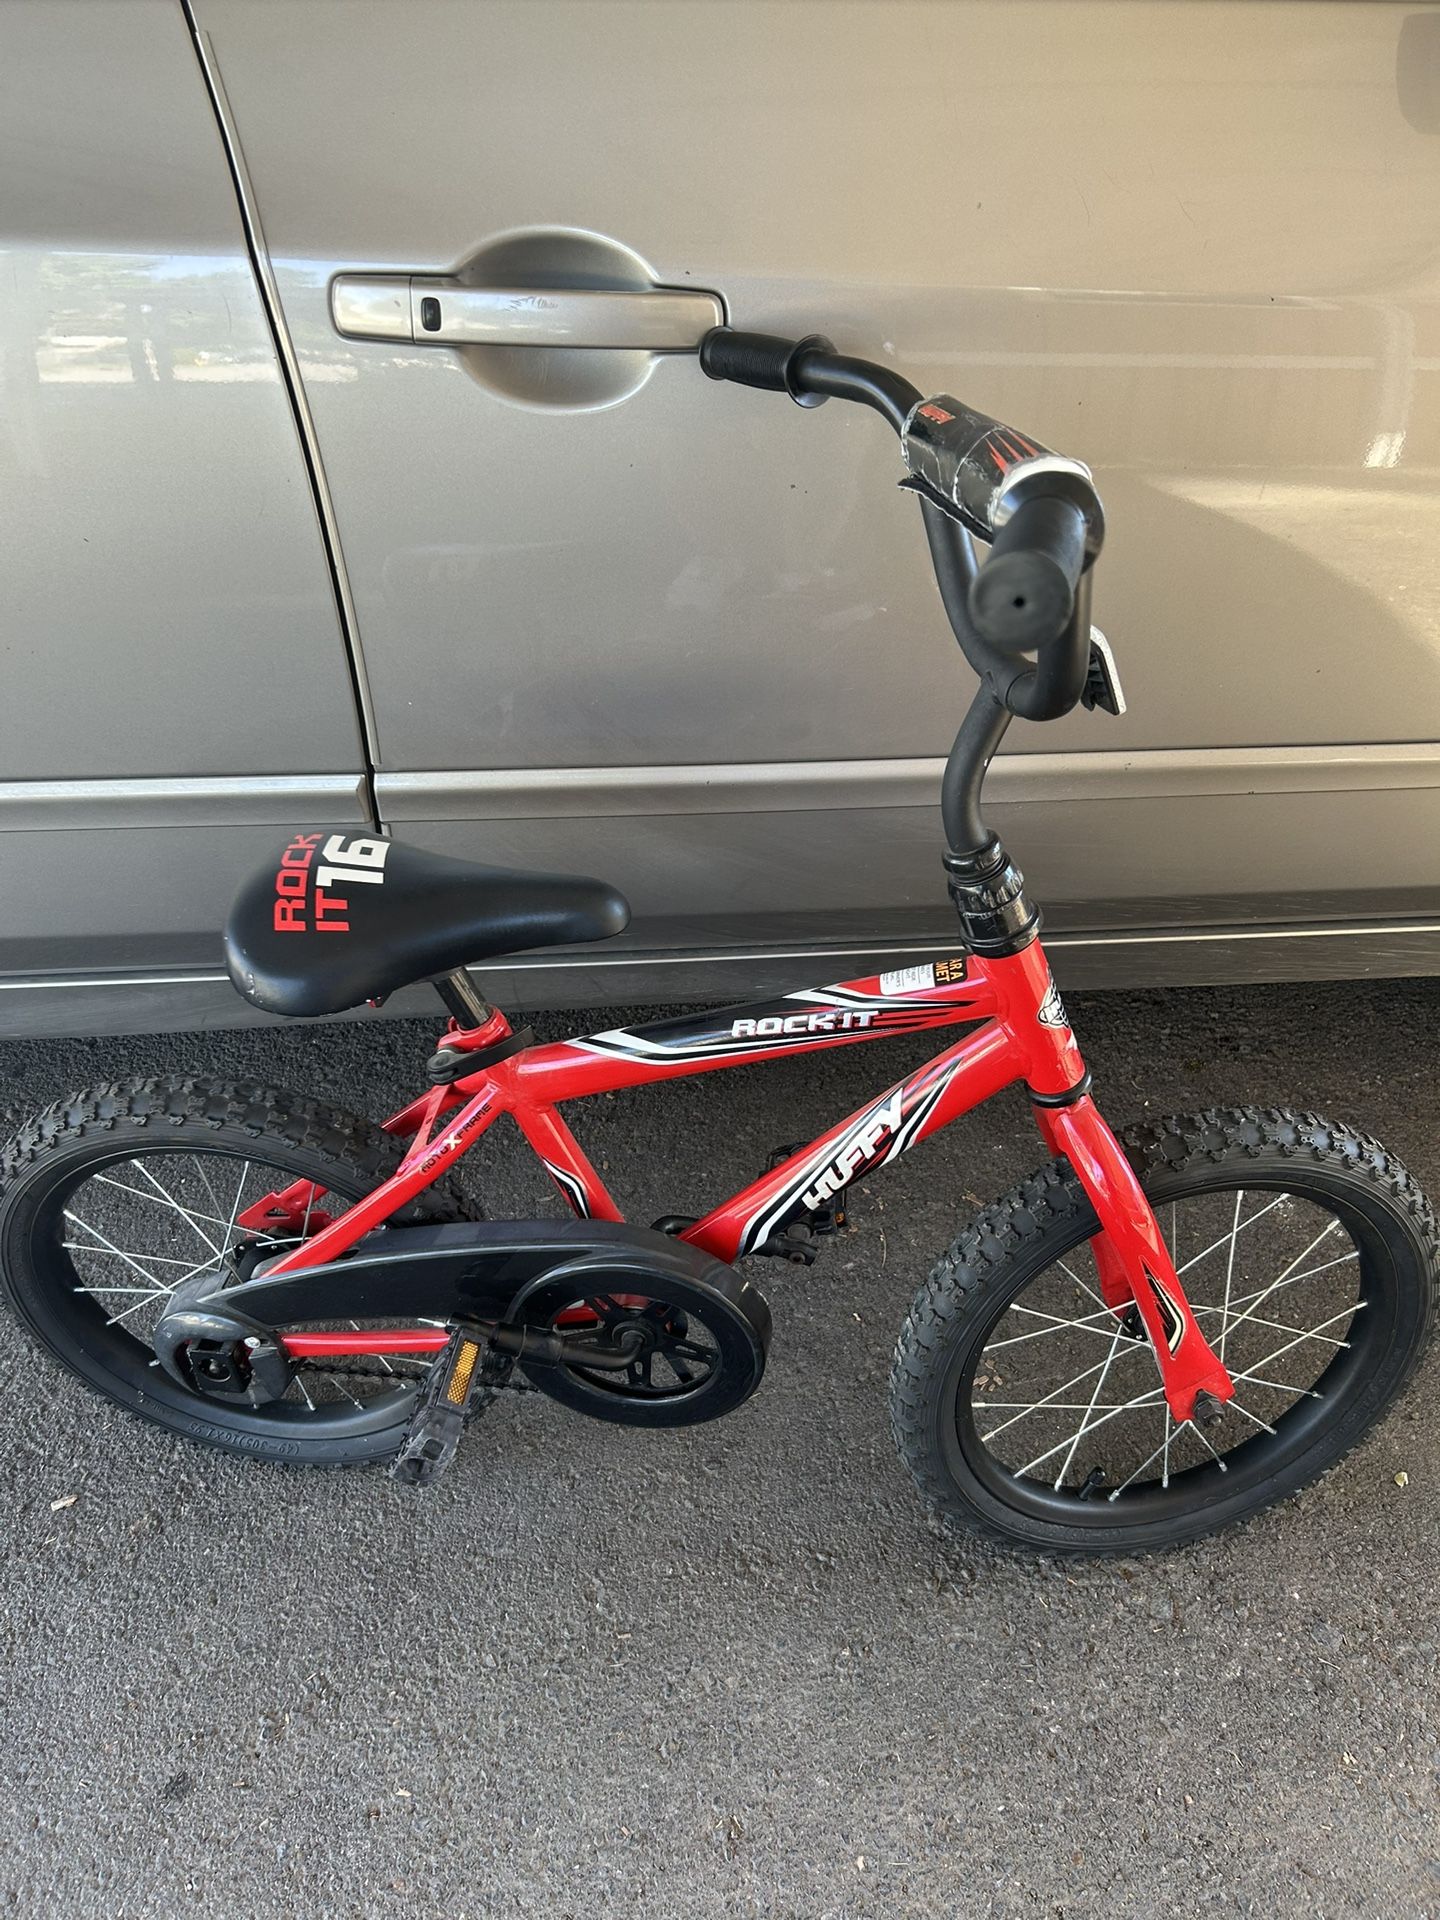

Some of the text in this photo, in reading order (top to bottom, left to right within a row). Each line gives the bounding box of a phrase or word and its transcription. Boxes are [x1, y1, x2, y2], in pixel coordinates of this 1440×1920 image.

[274, 833, 324, 931] ROCK
[315, 834, 391, 931] IT 16
[801, 1087, 903, 1211] HUFFY
